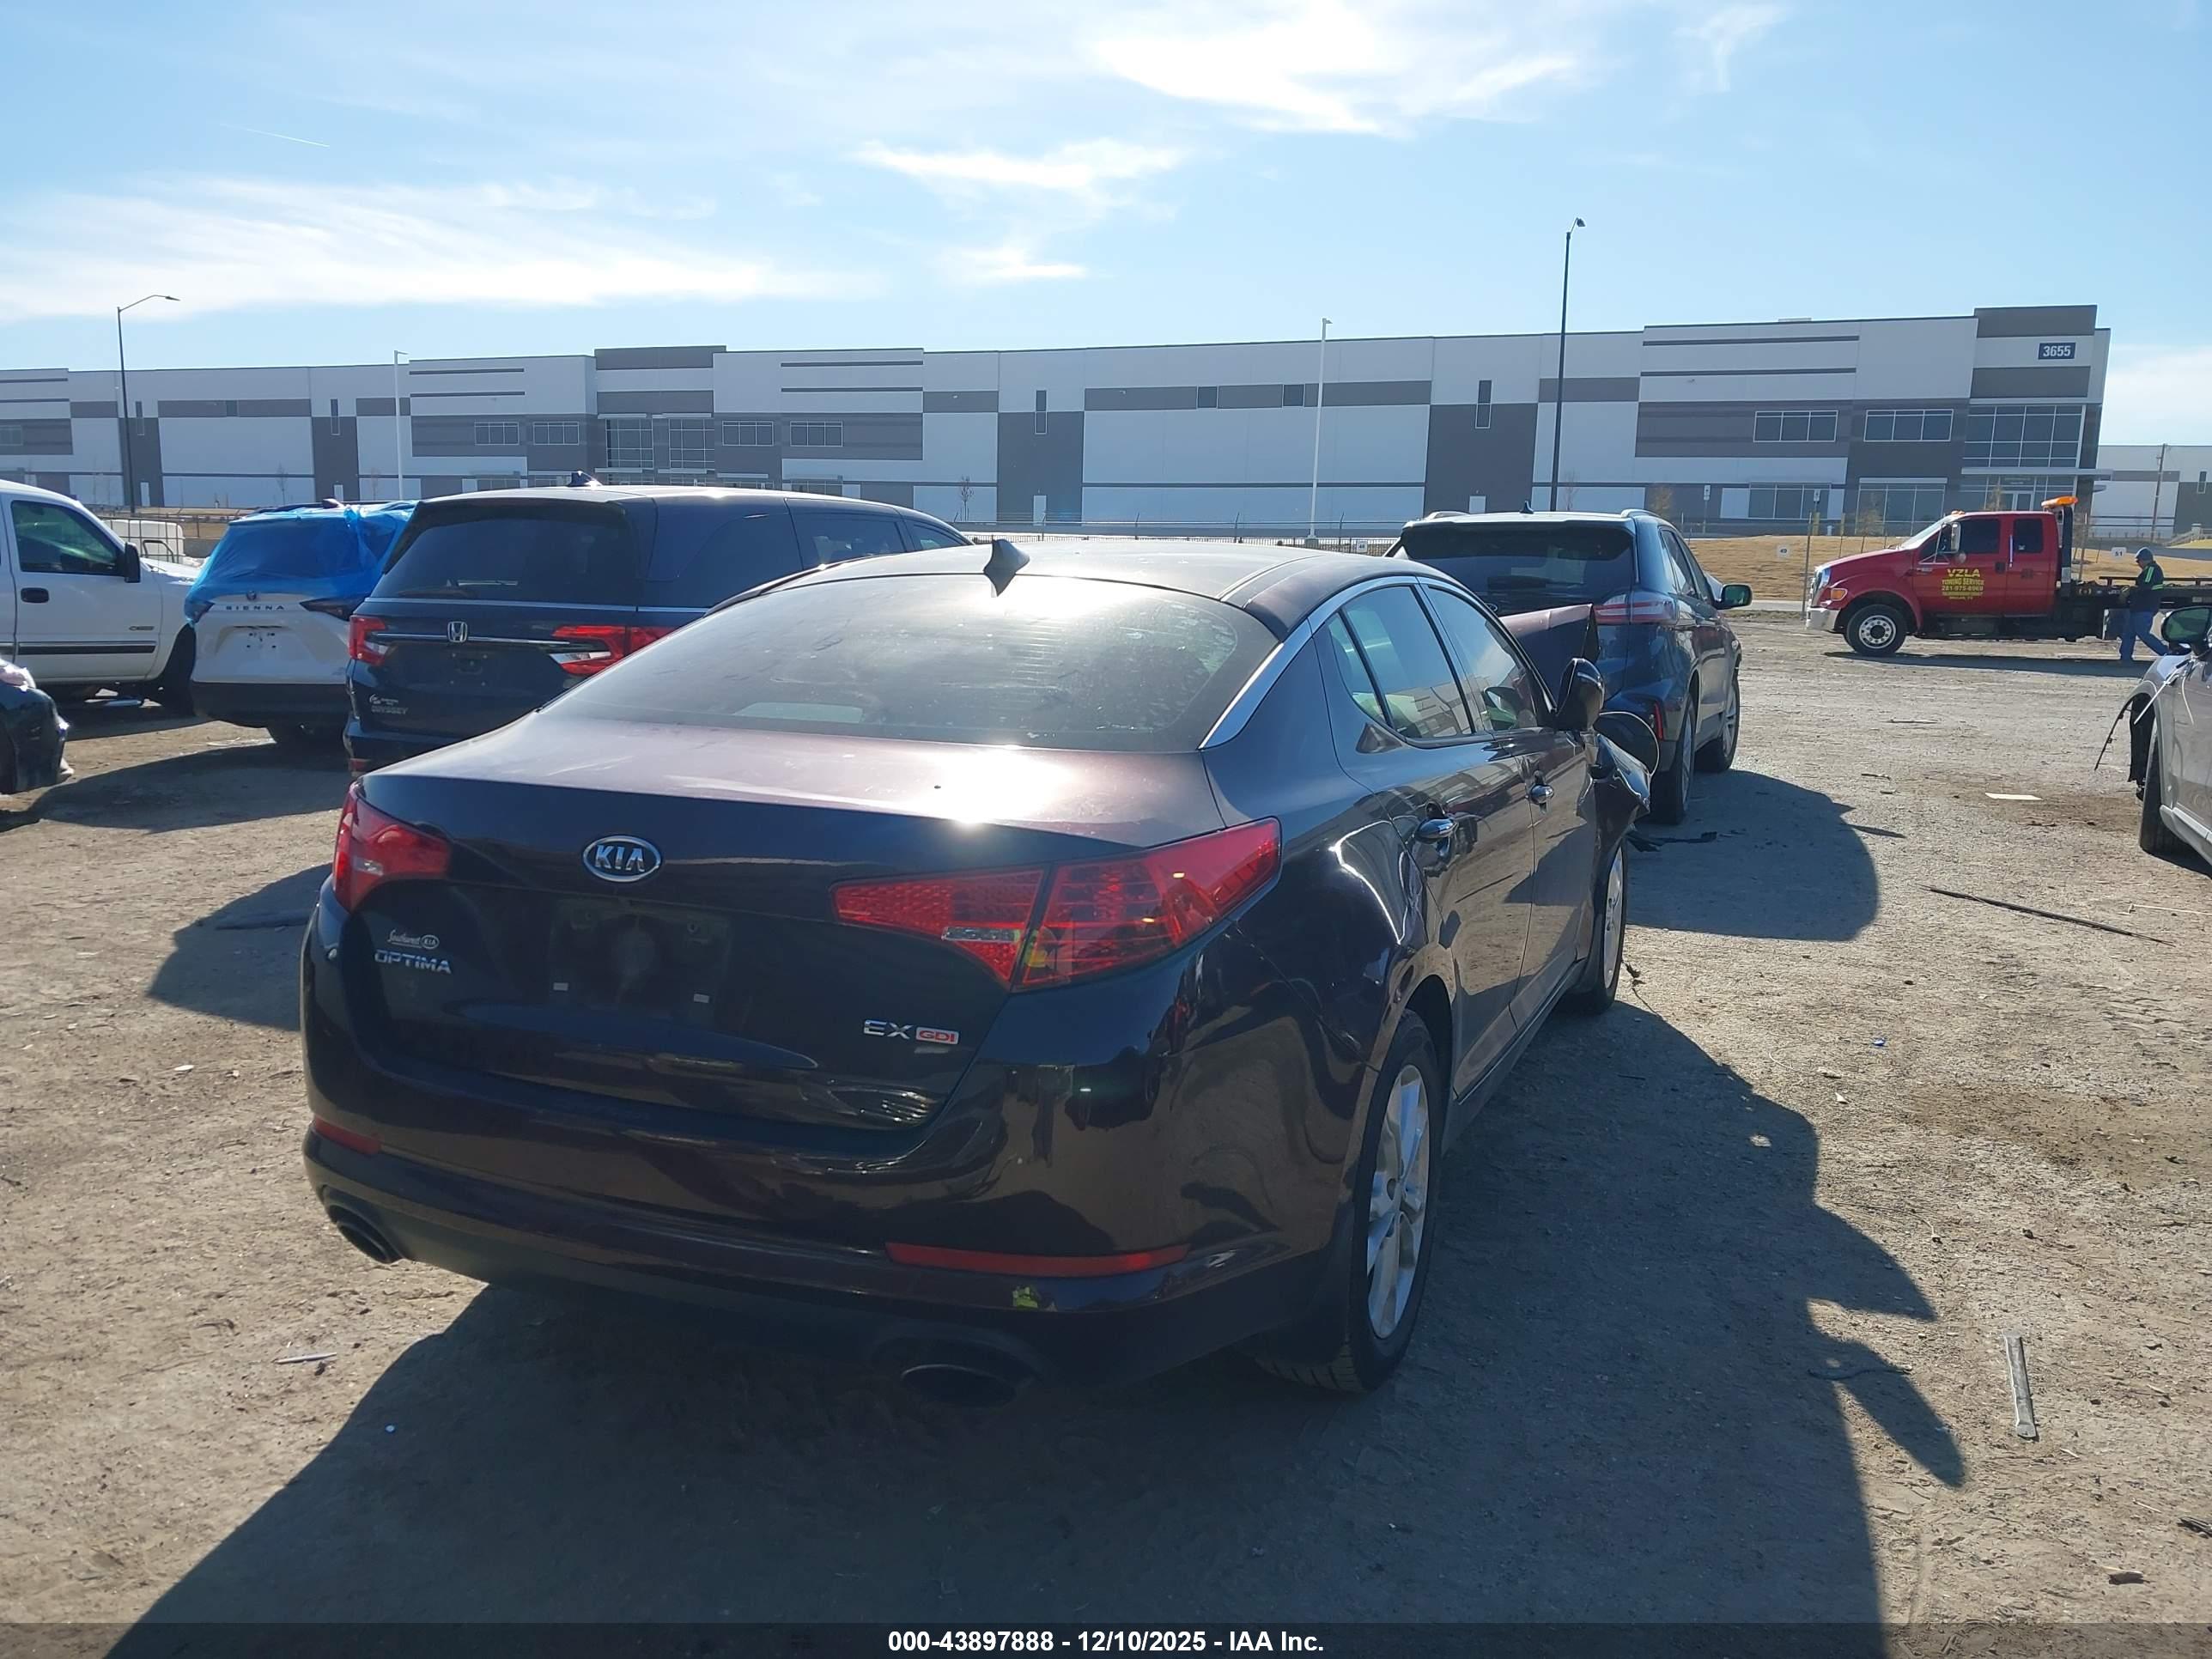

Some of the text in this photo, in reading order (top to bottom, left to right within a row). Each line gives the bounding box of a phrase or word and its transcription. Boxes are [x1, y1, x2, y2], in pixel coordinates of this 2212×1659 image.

[2043, 345, 2071, 357] 3655
[1946, 568, 1981, 578] VZLA
[594, 844, 646, 872] KIA
[374, 949, 452, 975] OPTIMA
[863, 1019, 956, 1042] EX GDI
